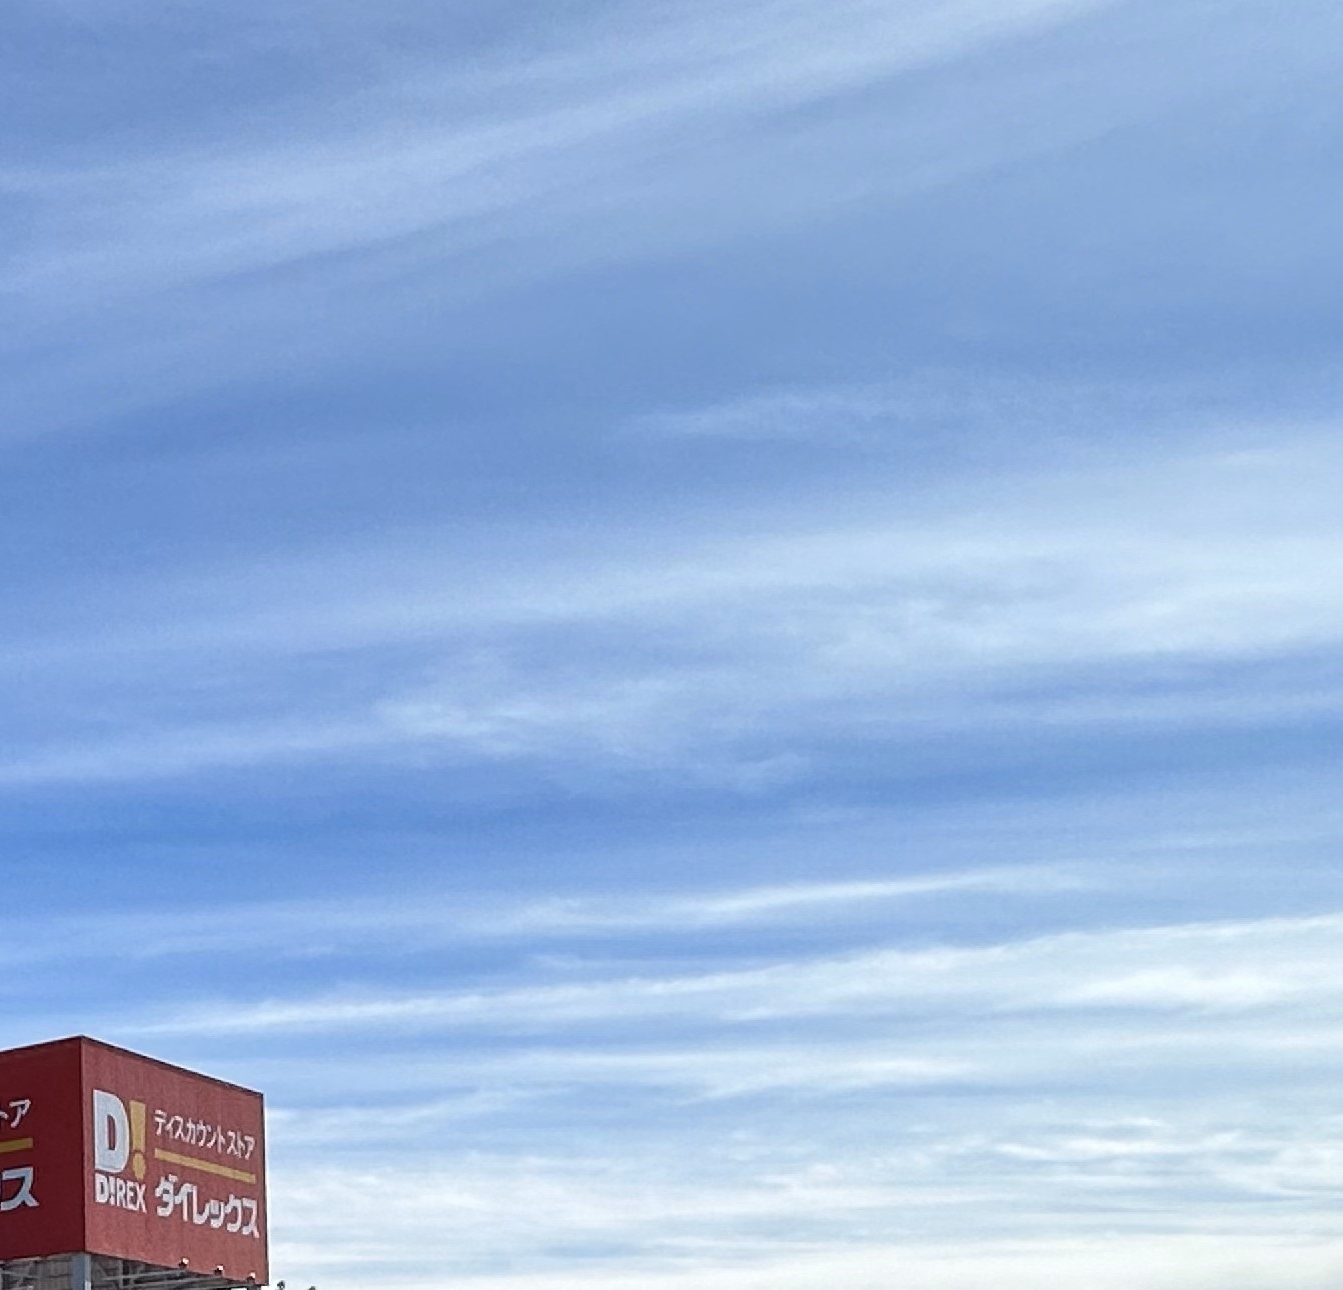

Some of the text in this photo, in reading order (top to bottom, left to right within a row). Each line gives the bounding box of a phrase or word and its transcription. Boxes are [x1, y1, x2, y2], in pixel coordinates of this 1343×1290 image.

[155, 1174, 259, 1238] ダイレックス
